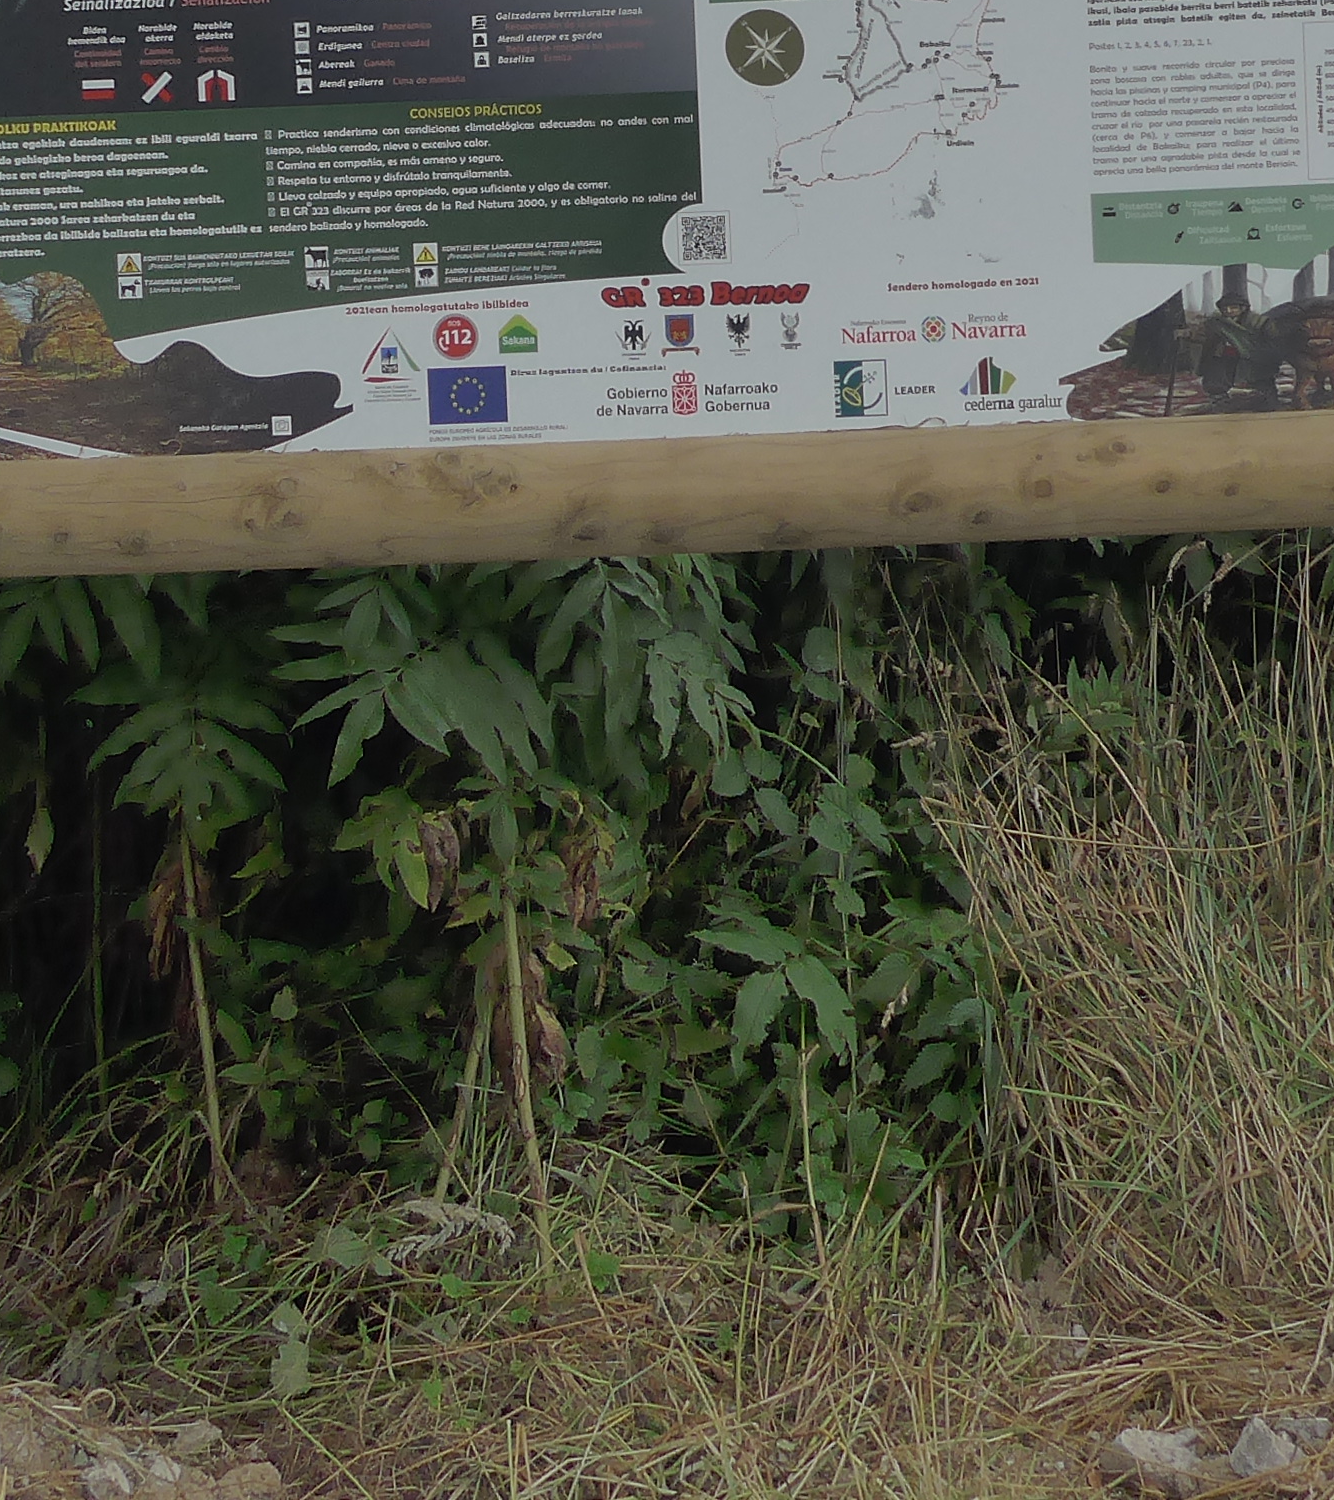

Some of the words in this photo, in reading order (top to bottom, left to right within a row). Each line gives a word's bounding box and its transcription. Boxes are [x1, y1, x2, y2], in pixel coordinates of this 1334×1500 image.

[318, 59, 355, 69] Abereak
[410, 106, 471, 119] CONSEJOS
[474, 103, 542, 116] PRÁCTICOS
[31, 119, 117, 134] PRAKTIKOAK
[278, 128, 319, 139] Practica
[323, 126, 378, 138] senderismo
[382, 127, 400, 136] con
[404, 123, 461, 135] condiciones
[464, 120, 535, 133] climatológicas
[600, 119, 613, 127] no
[617, 116, 647, 126] andes
[651, 117, 669, 125] con
[674, 114, 693, 124] mal
[265, 145, 304, 157] tiempo,
[306, 143, 337, 154] niebla
[339, 142, 381, 153] cerrada,
[383, 141, 410, 151] nieve
[412, 142, 419, 150] o
[421, 139, 462, 149] excesivo
[463, 137, 491, 148] calor.
[277, 160, 316, 170] Camina
[318, 161, 331, 169] en
[333, 157, 385, 169] compañía,
[399, 156, 420, 166] más
[422, 156, 457, 165] ameno
[459, 156, 466, 165] y
[468, 155, 504, 164] seguro.
[278, 175, 317, 187] Respeta
[319, 175, 331, 185] tu
[333, 174, 372, 184] entorno
[374, 175, 381, 184] y
[383, 171, 430, 182] disfrútalo
[432, 168, 512, 181] tranquilamente.
[269, 222, 308, 232] sendero
[310, 220, 353, 231] balizado
[354, 222, 362, 231] y
[364, 218, 429, 230] homologado.
[887, 281, 929, 292] Sendero
[931, 278, 997, 291] homologado
[1000, 279, 1013, 287] en
[1015, 277, 1039, 286] 2021
[657, 285, 705, 307] 323
[710, 281, 810, 306] Bernoa
[346, 306, 389, 315] 2021ean
[391, 302, 479, 314] homologatutako
[482, 300, 529, 309] ibilbidea
[968, 313, 996, 324] Reyno
[998, 312, 1009, 322] de
[442, 329, 473, 346] 112
[841, 325, 916, 344] Nafarroa
[951, 322, 1027, 340] Navarra
[502, 335, 536, 346] Sakana
[607, 387, 668, 400] Gobierno
[704, 382, 778, 396] Nafarroako
[894, 385, 936, 395] LEADER
[596, 405, 613, 417] de
[617, 404, 669, 416] Navarra
[705, 400, 770, 412] Gobernua
[964, 396, 1015, 412] cederna
[1018, 394, 1062, 413] garalur
